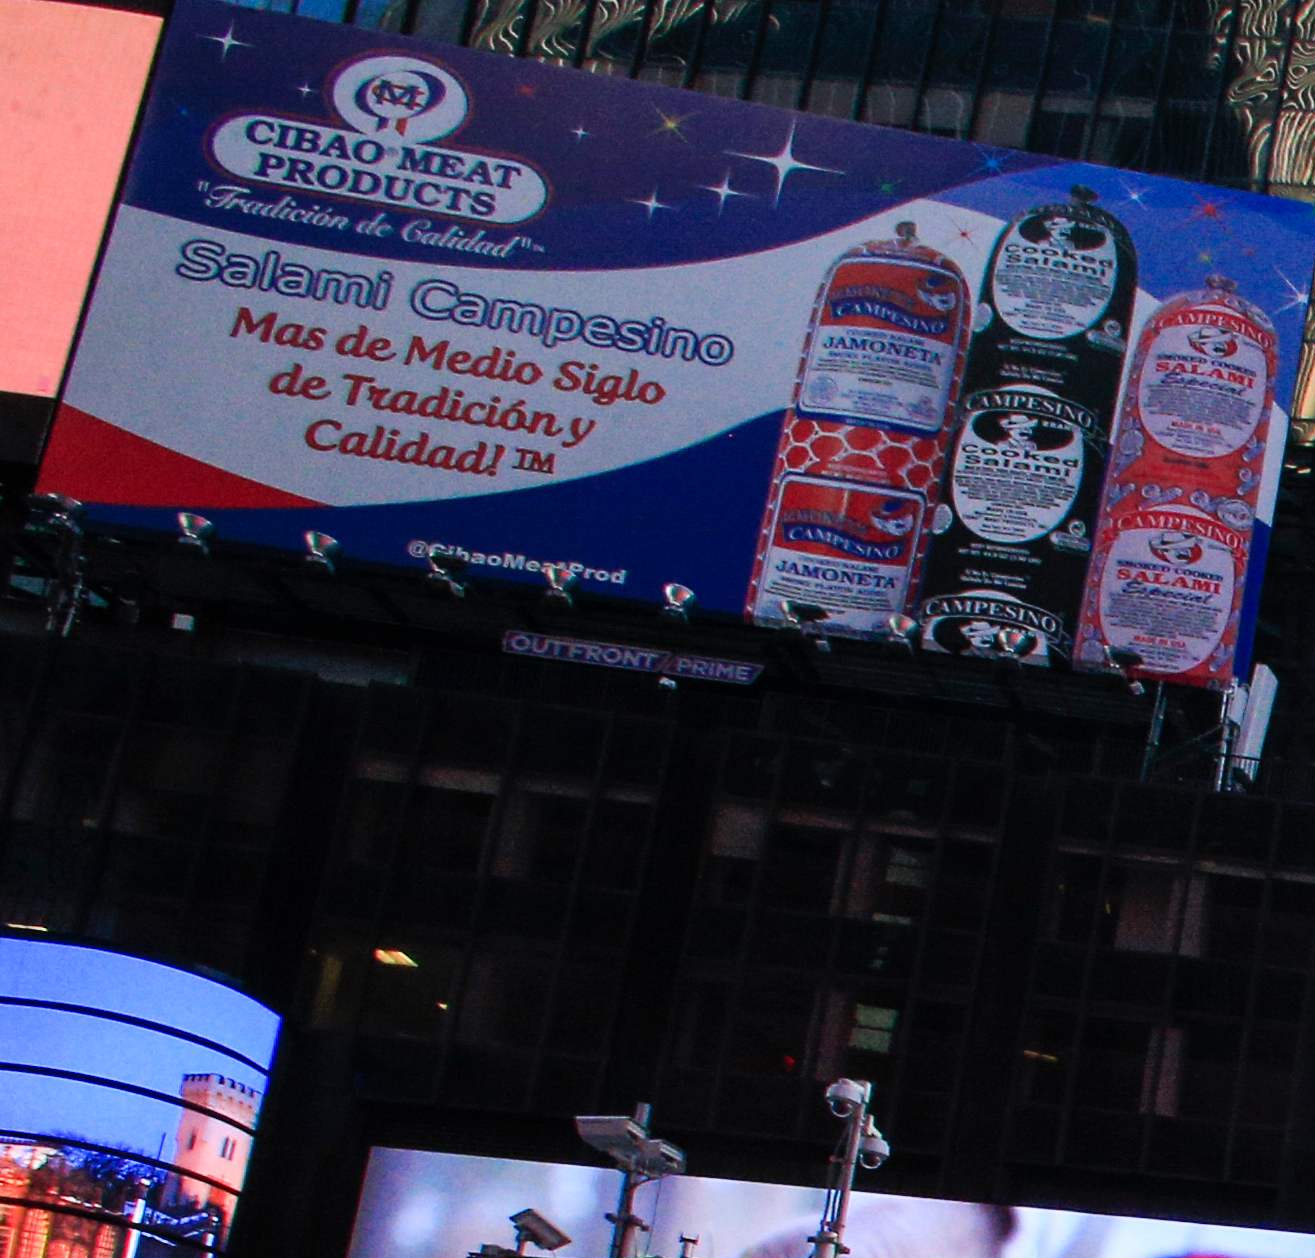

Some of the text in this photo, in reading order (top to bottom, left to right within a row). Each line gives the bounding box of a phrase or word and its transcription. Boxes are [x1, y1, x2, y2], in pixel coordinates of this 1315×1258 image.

[246, 119, 522, 190] CIBAO MEAT
[254, 153, 497, 217] PRODUCTS
[355, 213, 394, 238] de
[1004, 244, 1114, 270] Cooked
[1005, 254, 1107, 277] Salami
[176, 240, 735, 366] Salami Campesino
[1159, 313, 1272, 348] CAMPESINO
[230, 306, 666, 406] Mas de Medio Siglo
[823, 336, 943, 366] JAMONETA
[1156, 361, 1254, 389] SALAMI
[269, 364, 596, 449] de Tradición y
[966, 394, 1093, 429] CAMPESINO
[304, 419, 505, 477] Calidad!
[962, 444, 1079, 469] Cooked
[964, 455, 1071, 478] Salami
[788, 526, 899, 560] CAMPESINO
[1117, 515, 1239, 549] CAMPESINO
[776, 560, 896, 590] JAMONETA
[1116, 569, 1222, 595] SALAMI
[926, 600, 1057, 633] CAMPESINO
[510, 634, 753, 681] OUTFRONT PRIME
